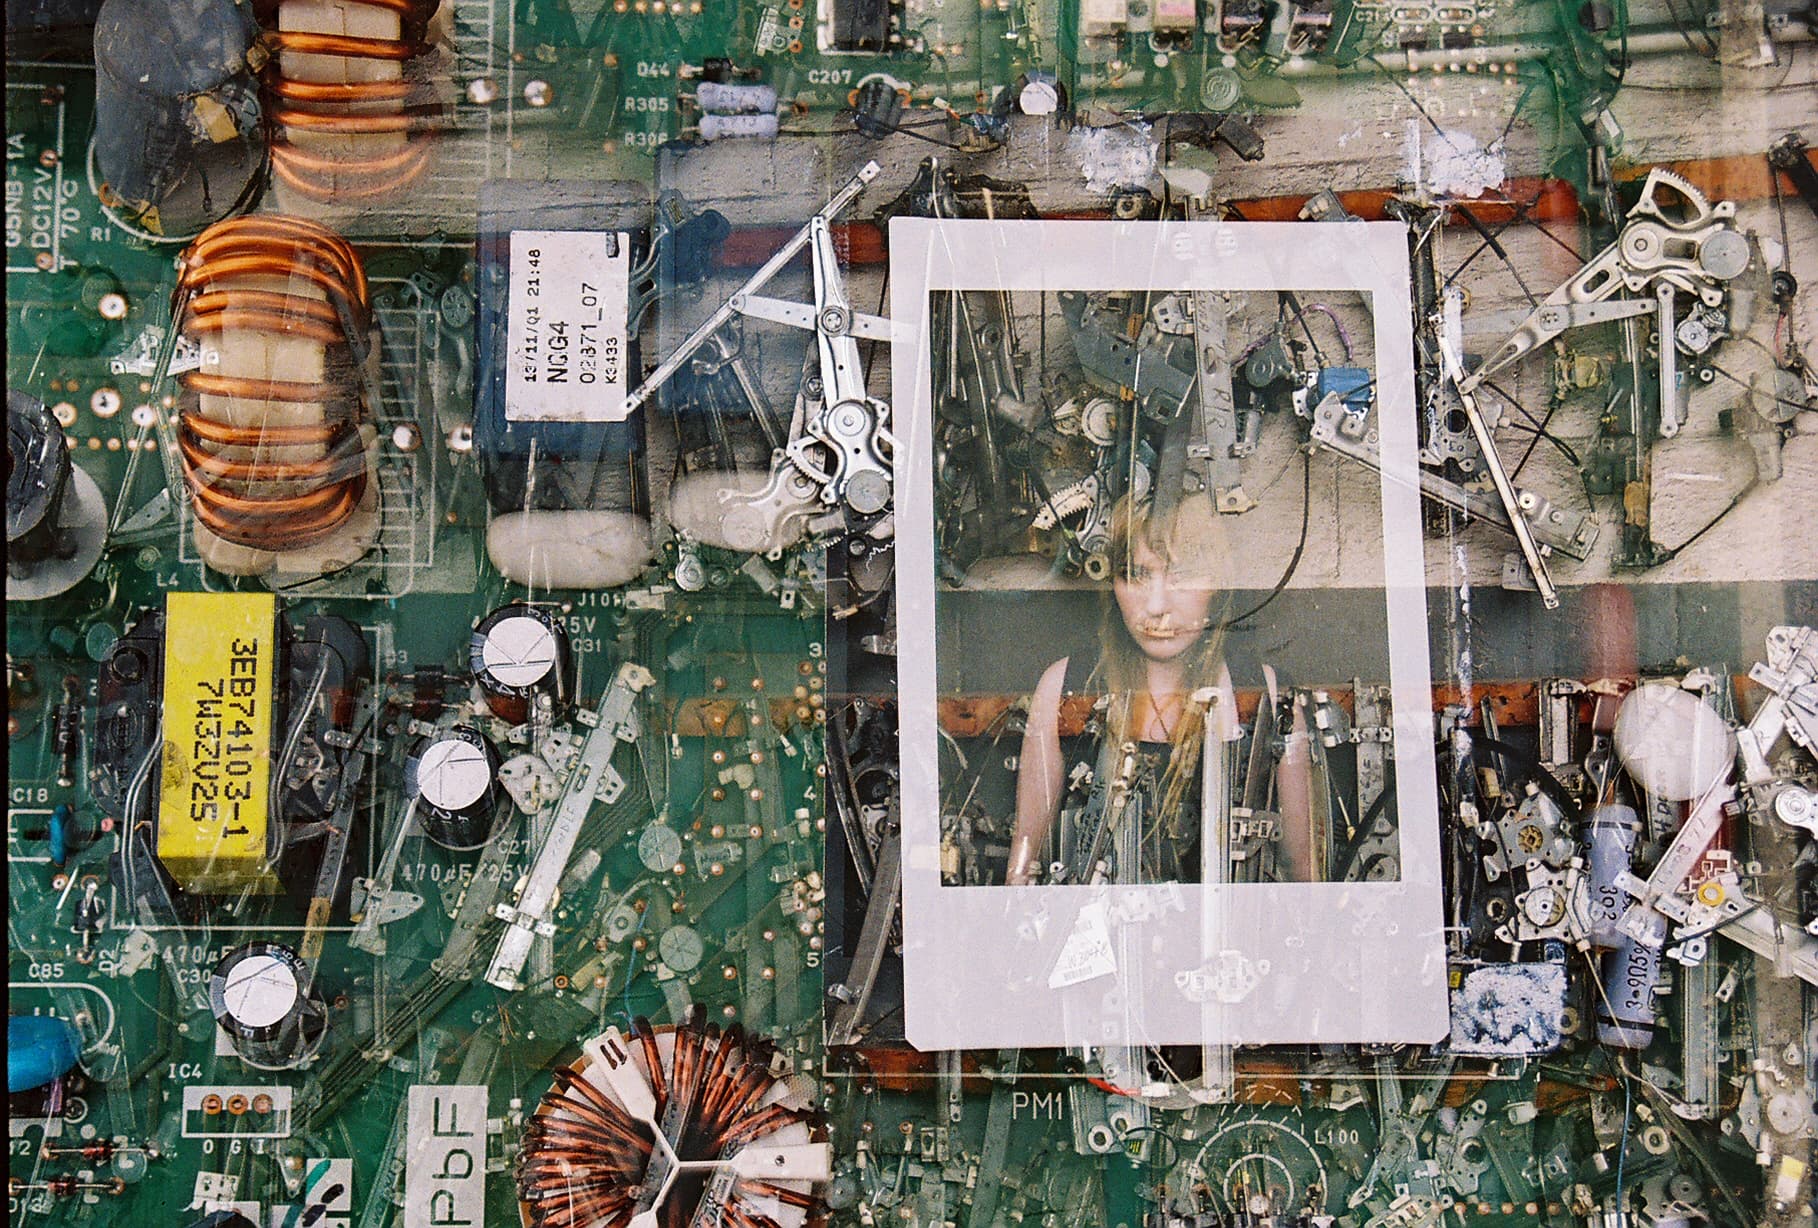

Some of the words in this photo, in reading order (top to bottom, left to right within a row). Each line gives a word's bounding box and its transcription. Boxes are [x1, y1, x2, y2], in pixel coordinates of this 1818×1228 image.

[808, 69, 853, 84] C207
[625, 97, 669, 112] R305
[31, 167, 53, 248] DC12V
[526, 248, 541, 297] 21:48
[156, 571, 179, 587] L4
[809, 642, 822, 658] 3
[222, 638, 258, 839] 3EB74103-1
[13, 788, 49, 803] C18
[803, 786, 816, 801] 4
[497, 839, 531, 855] C27
[806, 952, 820, 968] 5
[28, 962, 65, 979] C85
[168, 1063, 203, 1079] IC4
[1012, 1091, 1063, 1121] PM1
[1314, 1129, 1359, 1145] L100
[430, 1096, 474, 1226] PbF
